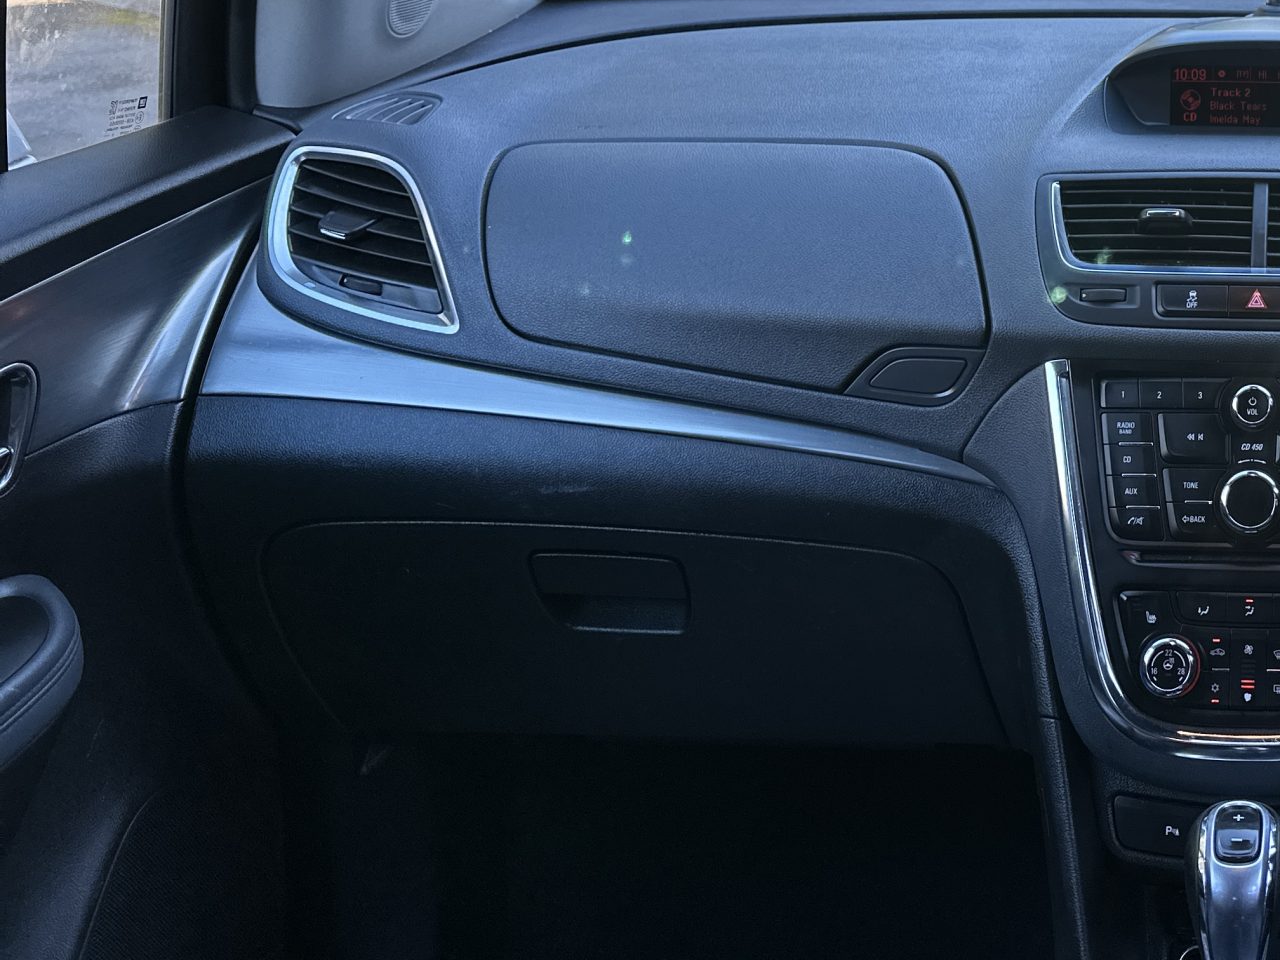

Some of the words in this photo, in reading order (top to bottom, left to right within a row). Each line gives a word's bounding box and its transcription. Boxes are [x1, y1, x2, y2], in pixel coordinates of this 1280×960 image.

[1174, 68, 1207, 82] 10:09
[1210, 87, 1241, 98] Track
[1244, 87, 1252, 98] 2
[1183, 111, 1198, 124] CD
[1186, 300, 1198, 309] OFF
[1156, 390, 1162, 399] 2
[1197, 391, 1203, 400] 3
[1246, 408, 1258, 416] VOL
[1116, 421, 1135, 429] RADIO
[1240, 443, 1251, 451] CD
[1251, 443, 1264, 451] 450
[1122, 455, 1131, 463] CD
[1182, 481, 1199, 489] TONE
[1124, 487, 1138, 495] AUX
[1189, 515, 1206, 523] BACK
[1164, 649, 1173, 657] 22
[1151, 667, 1158, 676] 16
[1177, 667, 1186, 676] 28
